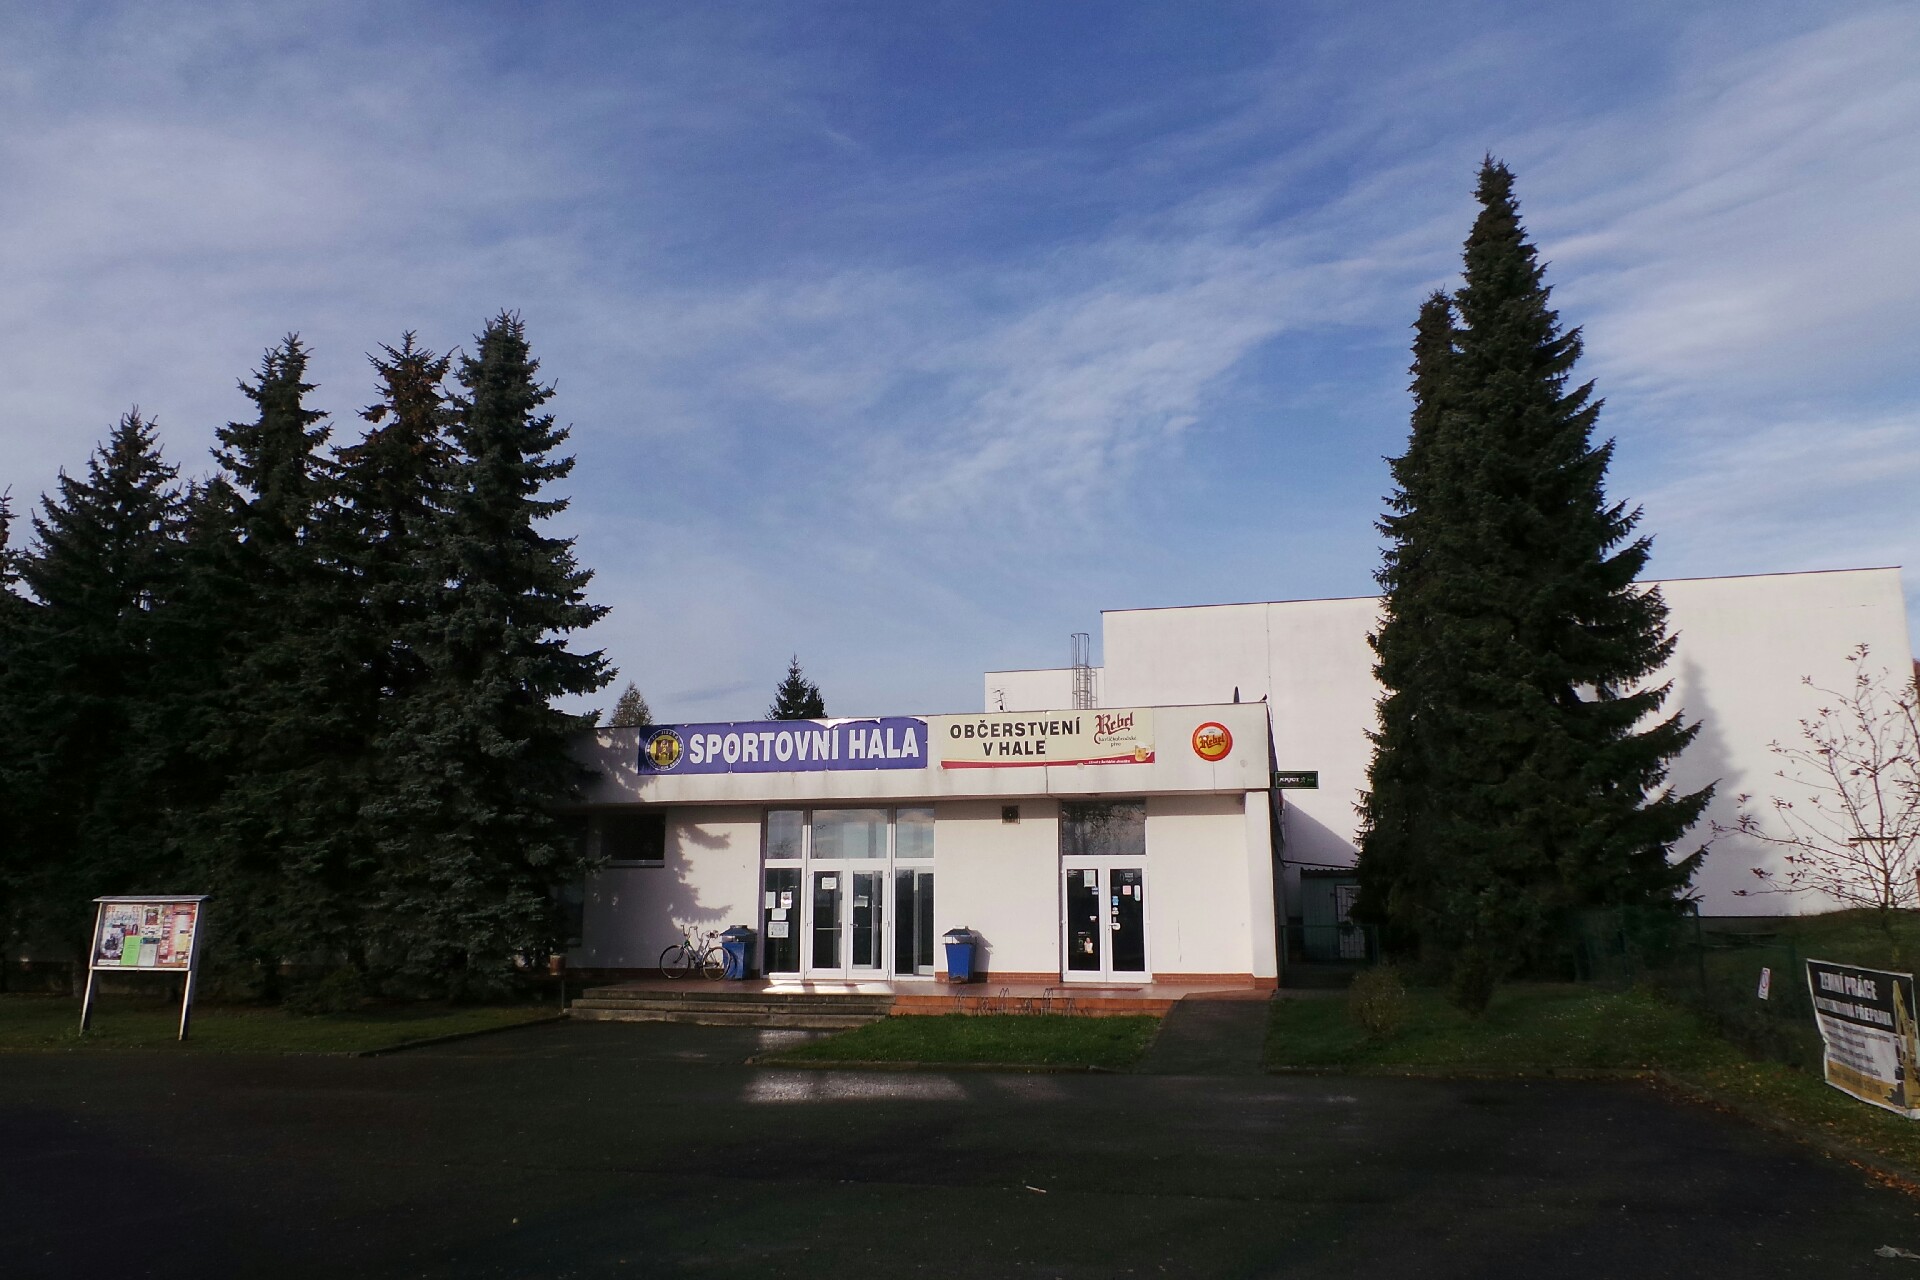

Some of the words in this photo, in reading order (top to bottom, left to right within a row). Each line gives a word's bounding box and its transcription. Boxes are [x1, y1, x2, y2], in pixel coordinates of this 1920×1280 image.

[950, 717, 1081, 738] OBČERSTVENÍ
[1094, 712, 1134, 735] Rebel
[689, 727, 839, 764] SPORTOVNÍ
[849, 727, 920, 760] HALA
[982, 742, 993, 756] V
[999, 740, 1046, 756] HALE
[1198, 733, 1225, 749] Rebel
